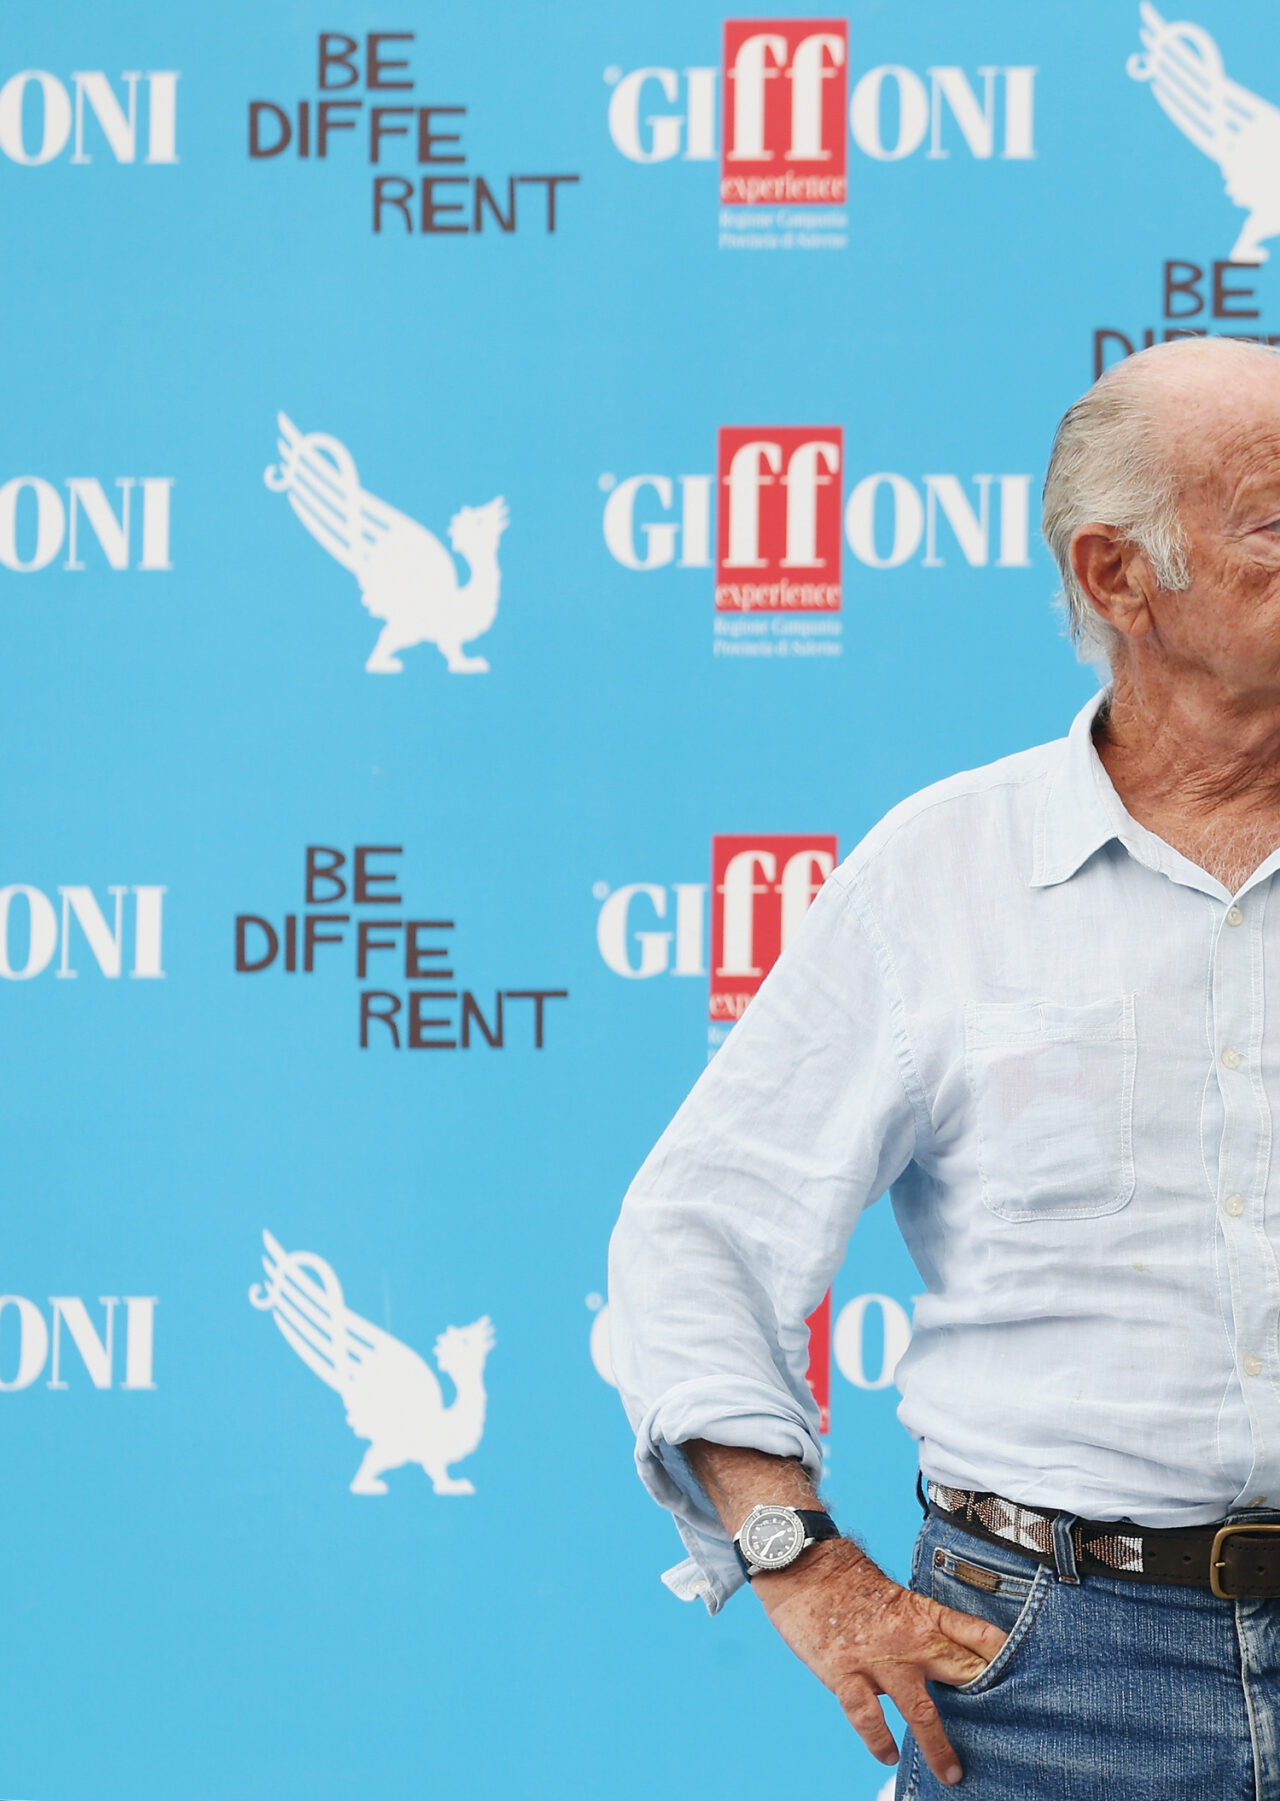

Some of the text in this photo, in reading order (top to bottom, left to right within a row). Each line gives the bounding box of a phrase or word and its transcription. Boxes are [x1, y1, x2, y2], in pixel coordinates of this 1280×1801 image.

[319, 33, 415, 90] BE
[248, 101, 466, 164] DIFFE
[373, 176, 580, 234] RENT
[719, 169, 846, 205] experience
[1164, 261, 1261, 319] BE
[715, 577, 842, 612] experience
[306, 846, 403, 904] BE
[235, 914, 454, 979] DIFFE
[359, 990, 569, 1049] RENT
